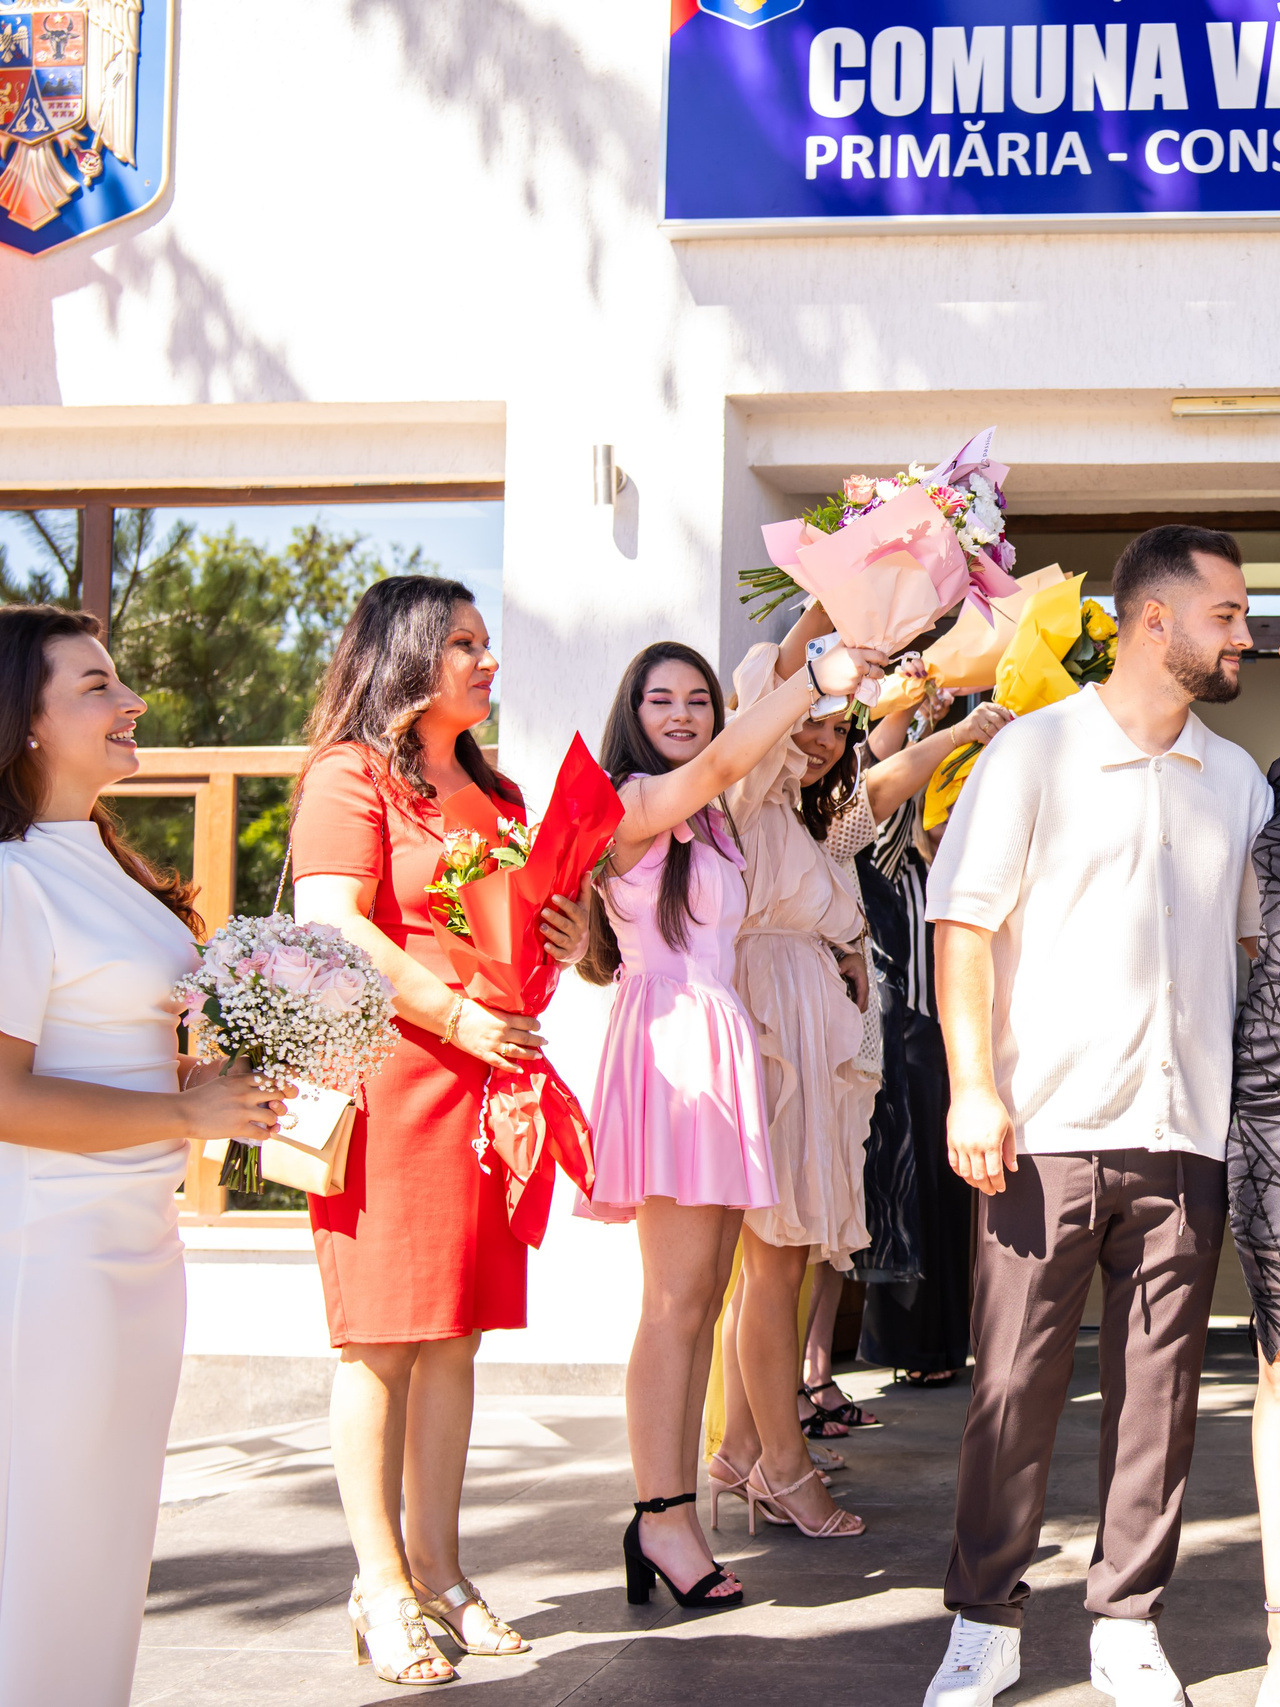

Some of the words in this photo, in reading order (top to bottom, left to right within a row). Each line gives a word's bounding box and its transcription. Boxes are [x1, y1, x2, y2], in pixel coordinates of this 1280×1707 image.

[808, 22, 1189, 119] COMUNA
[805, 120, 1092, 180] PRIMĂRIA
[1107, 152, 1128, 162] -
